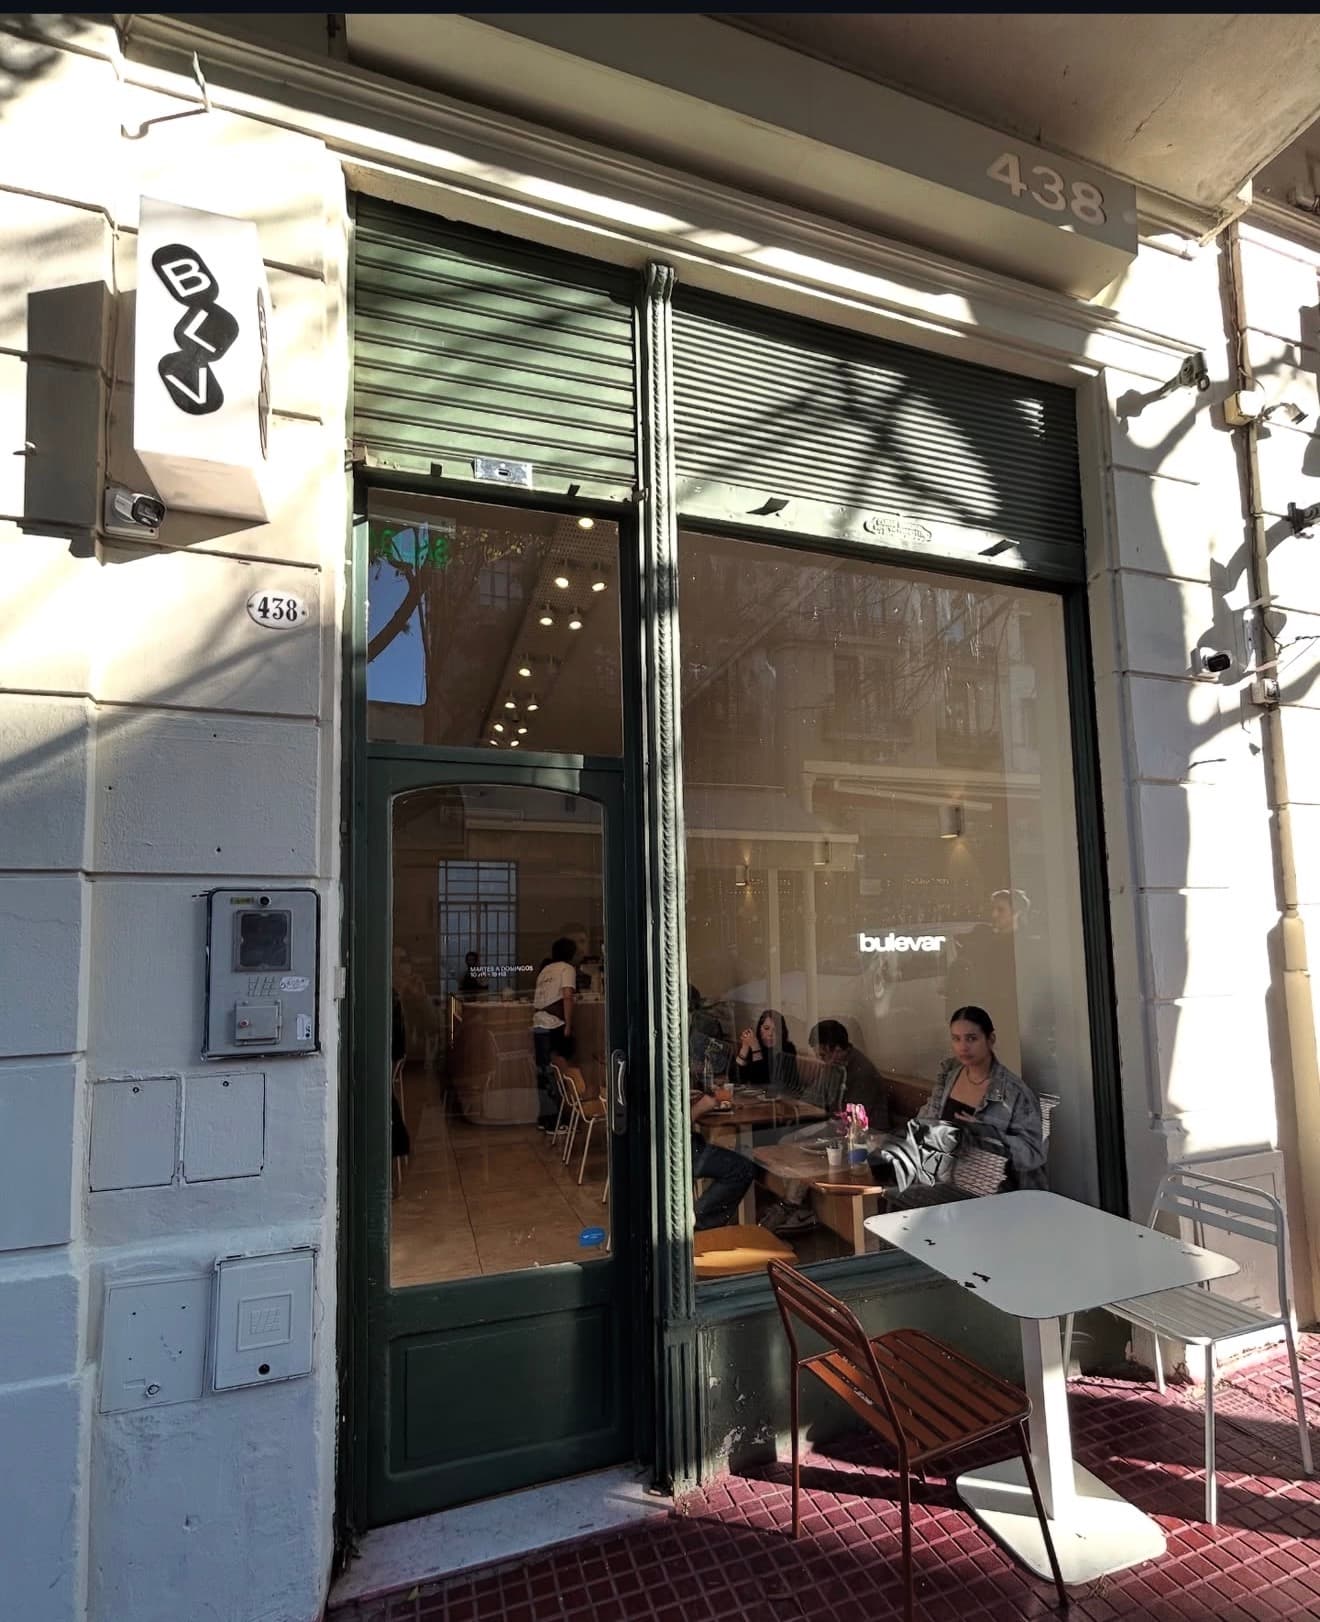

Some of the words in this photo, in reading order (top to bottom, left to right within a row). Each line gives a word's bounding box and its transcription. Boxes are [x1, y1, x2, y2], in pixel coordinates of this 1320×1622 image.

[986, 152, 1106, 224] 438
[161, 258, 217, 405] BLV
[258, 597, 298, 621] 438
[859, 932, 946, 952] bulevar
